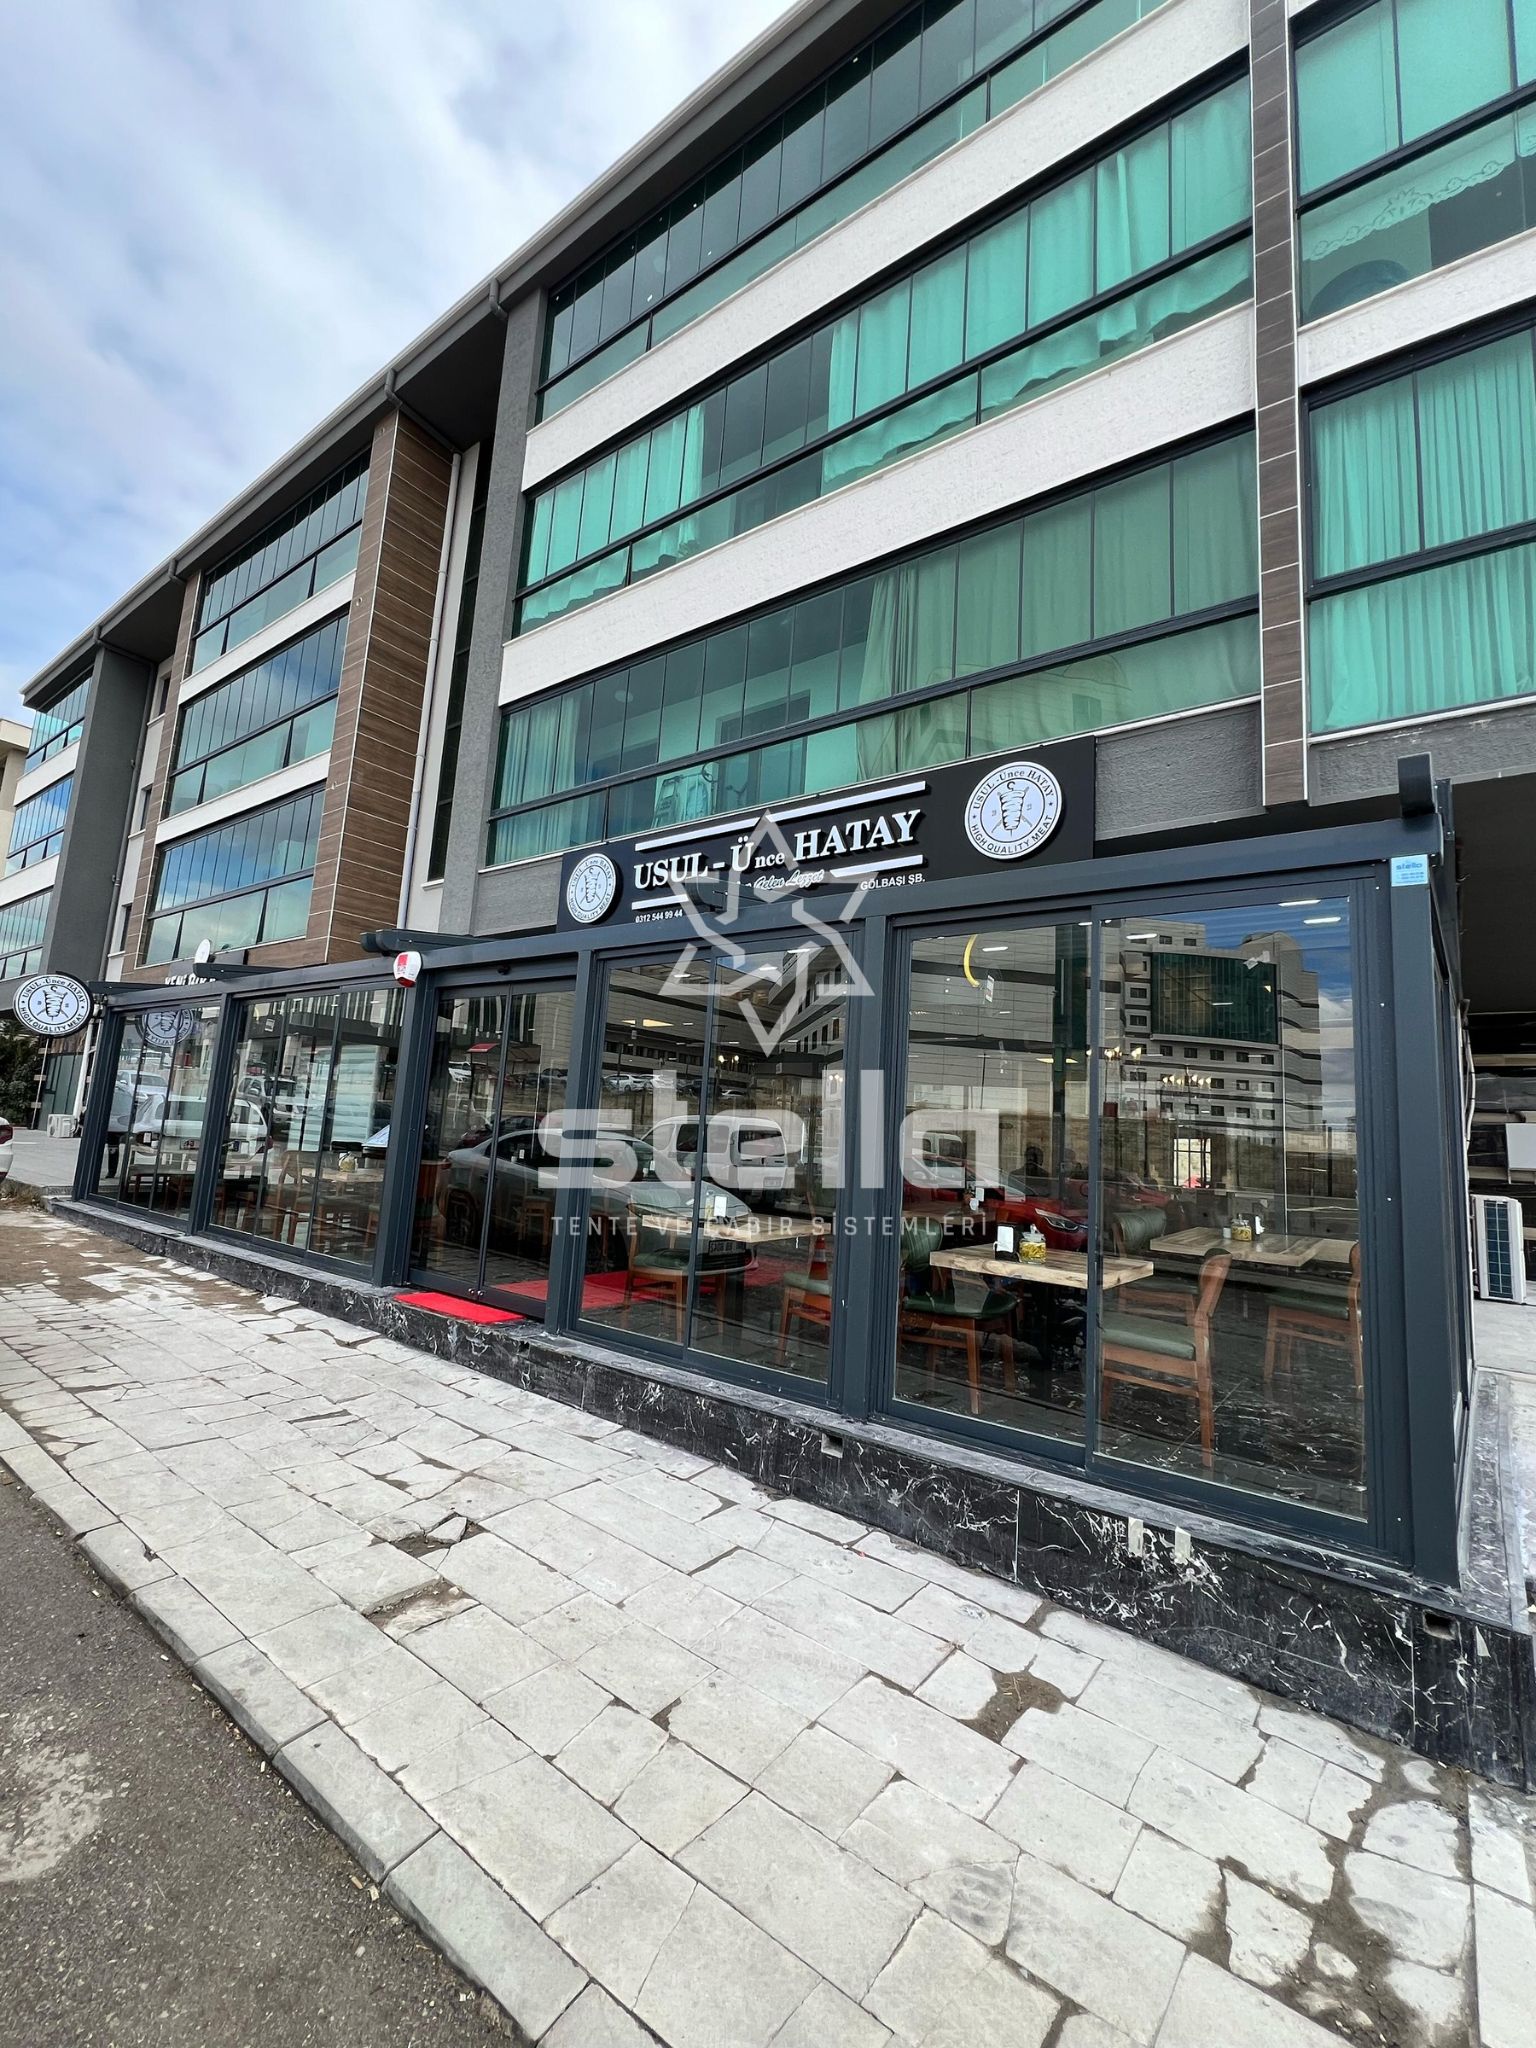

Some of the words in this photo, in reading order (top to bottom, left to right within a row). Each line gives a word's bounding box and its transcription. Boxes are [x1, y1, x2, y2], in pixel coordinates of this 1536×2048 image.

[973, 782, 995, 809] USUL
[1027, 770, 1054, 797] HATAY
[971, 824, 988, 847] HIGH
[987, 840, 1031, 854] QUALITY
[1031, 815, 1053, 842] MEAT
[633, 853, 710, 889] USUL
[793, 809, 921, 862] HATAY
[860, 875, 906, 891] GÖLBAŞI
[635, 914, 651, 923] 0312
[651, 911, 664, 921] 544
[674, 908, 683, 918] 44
[22, 982, 41, 998] USUL
[67, 983, 85, 1003] HATAY
[32, 1021, 67, 1032] QUALITY
[67, 1013, 83, 1027] MEAT
